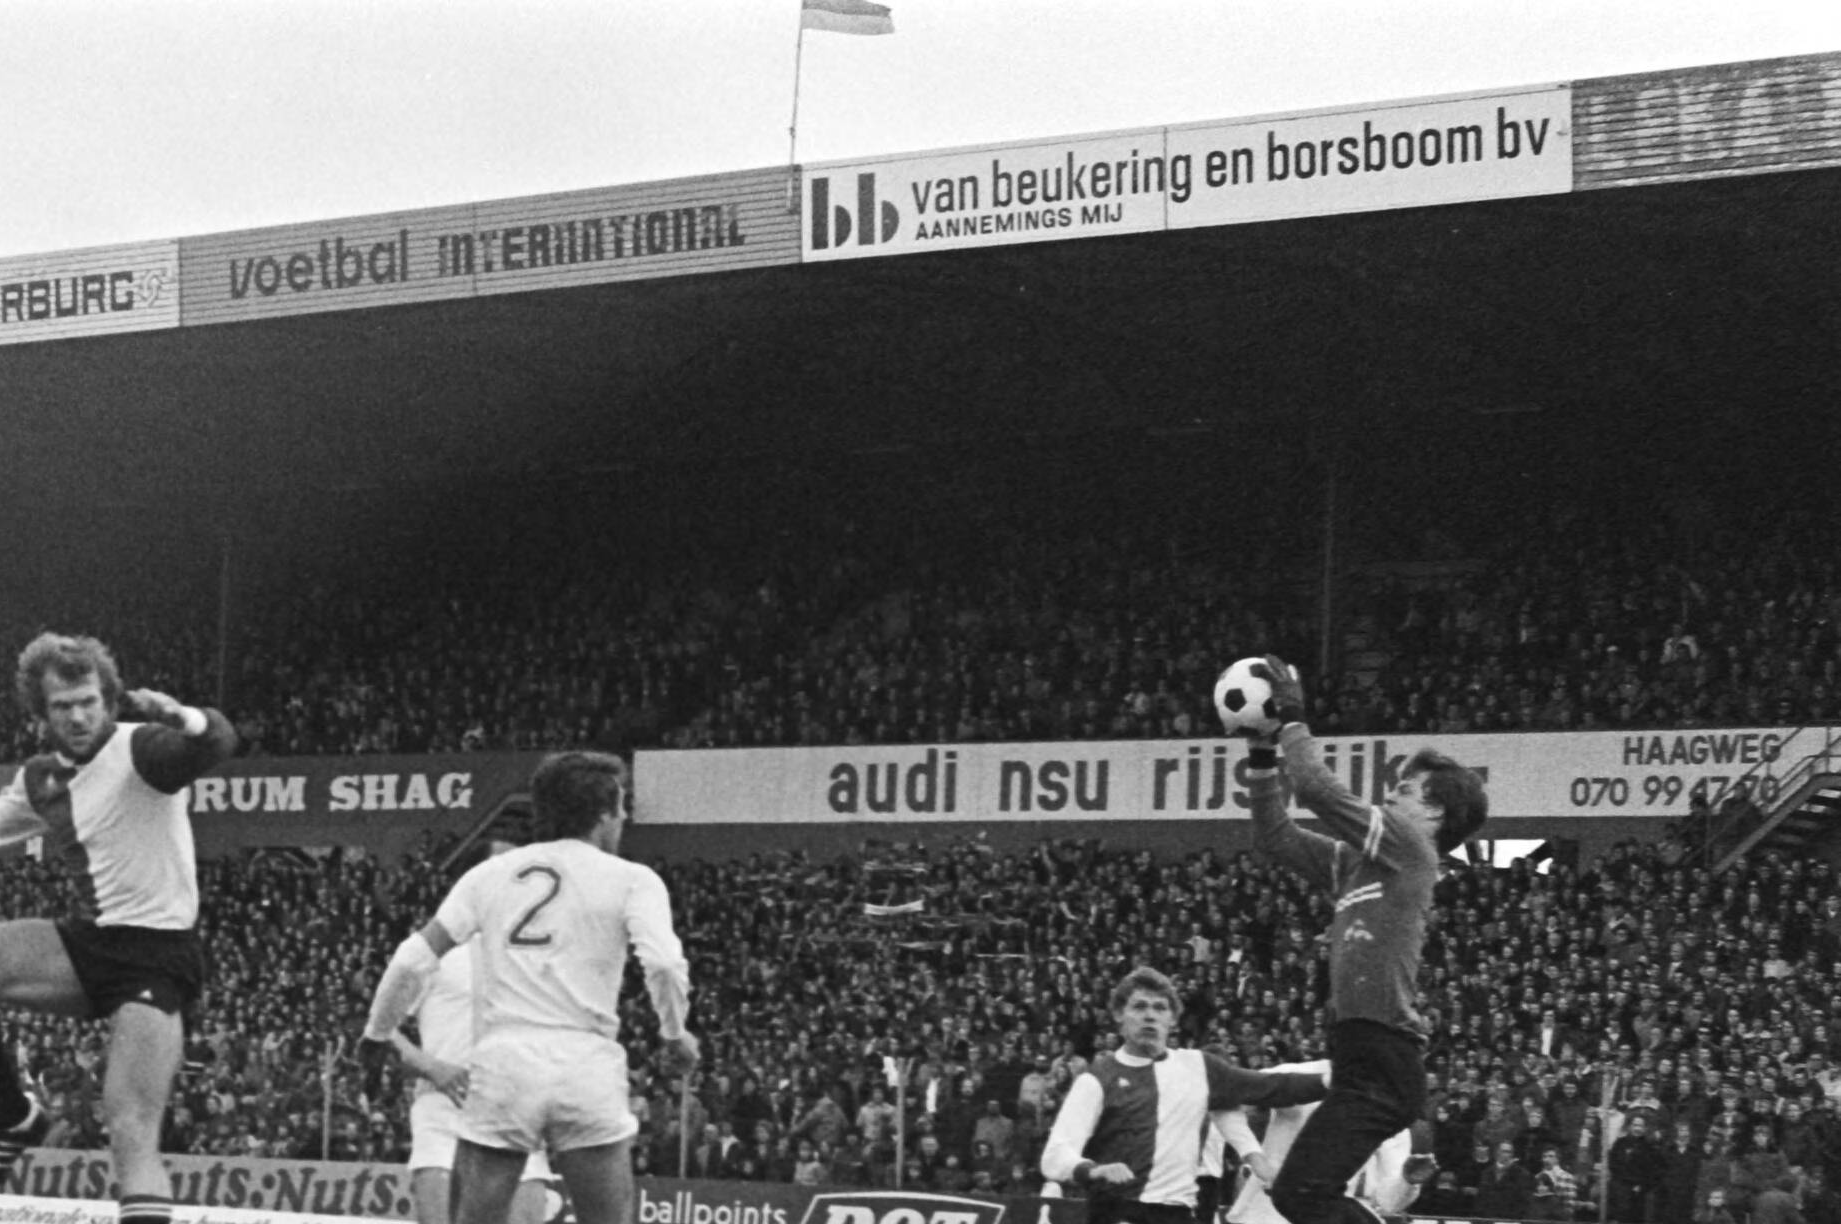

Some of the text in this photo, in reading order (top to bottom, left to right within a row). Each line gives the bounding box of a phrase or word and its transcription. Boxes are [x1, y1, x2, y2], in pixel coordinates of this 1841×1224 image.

[911, 104, 1551, 215] van beukering en borsboom bv
[914, 201, 1125, 242] AANNEMINGS MIJ
[229, 204, 747, 299] voetbal INTERNATIONAL
[1623, 733, 1781, 767] HAAGWEG
[193, 772, 474, 813] RUM SHAG
[828, 747, 957, 813] audi
[999, 759, 1109, 813] nsu
[1570, 777, 1628, 807] 070
[509, 865, 561, 946] 2
[167, 1160, 263, 1207] uts.
